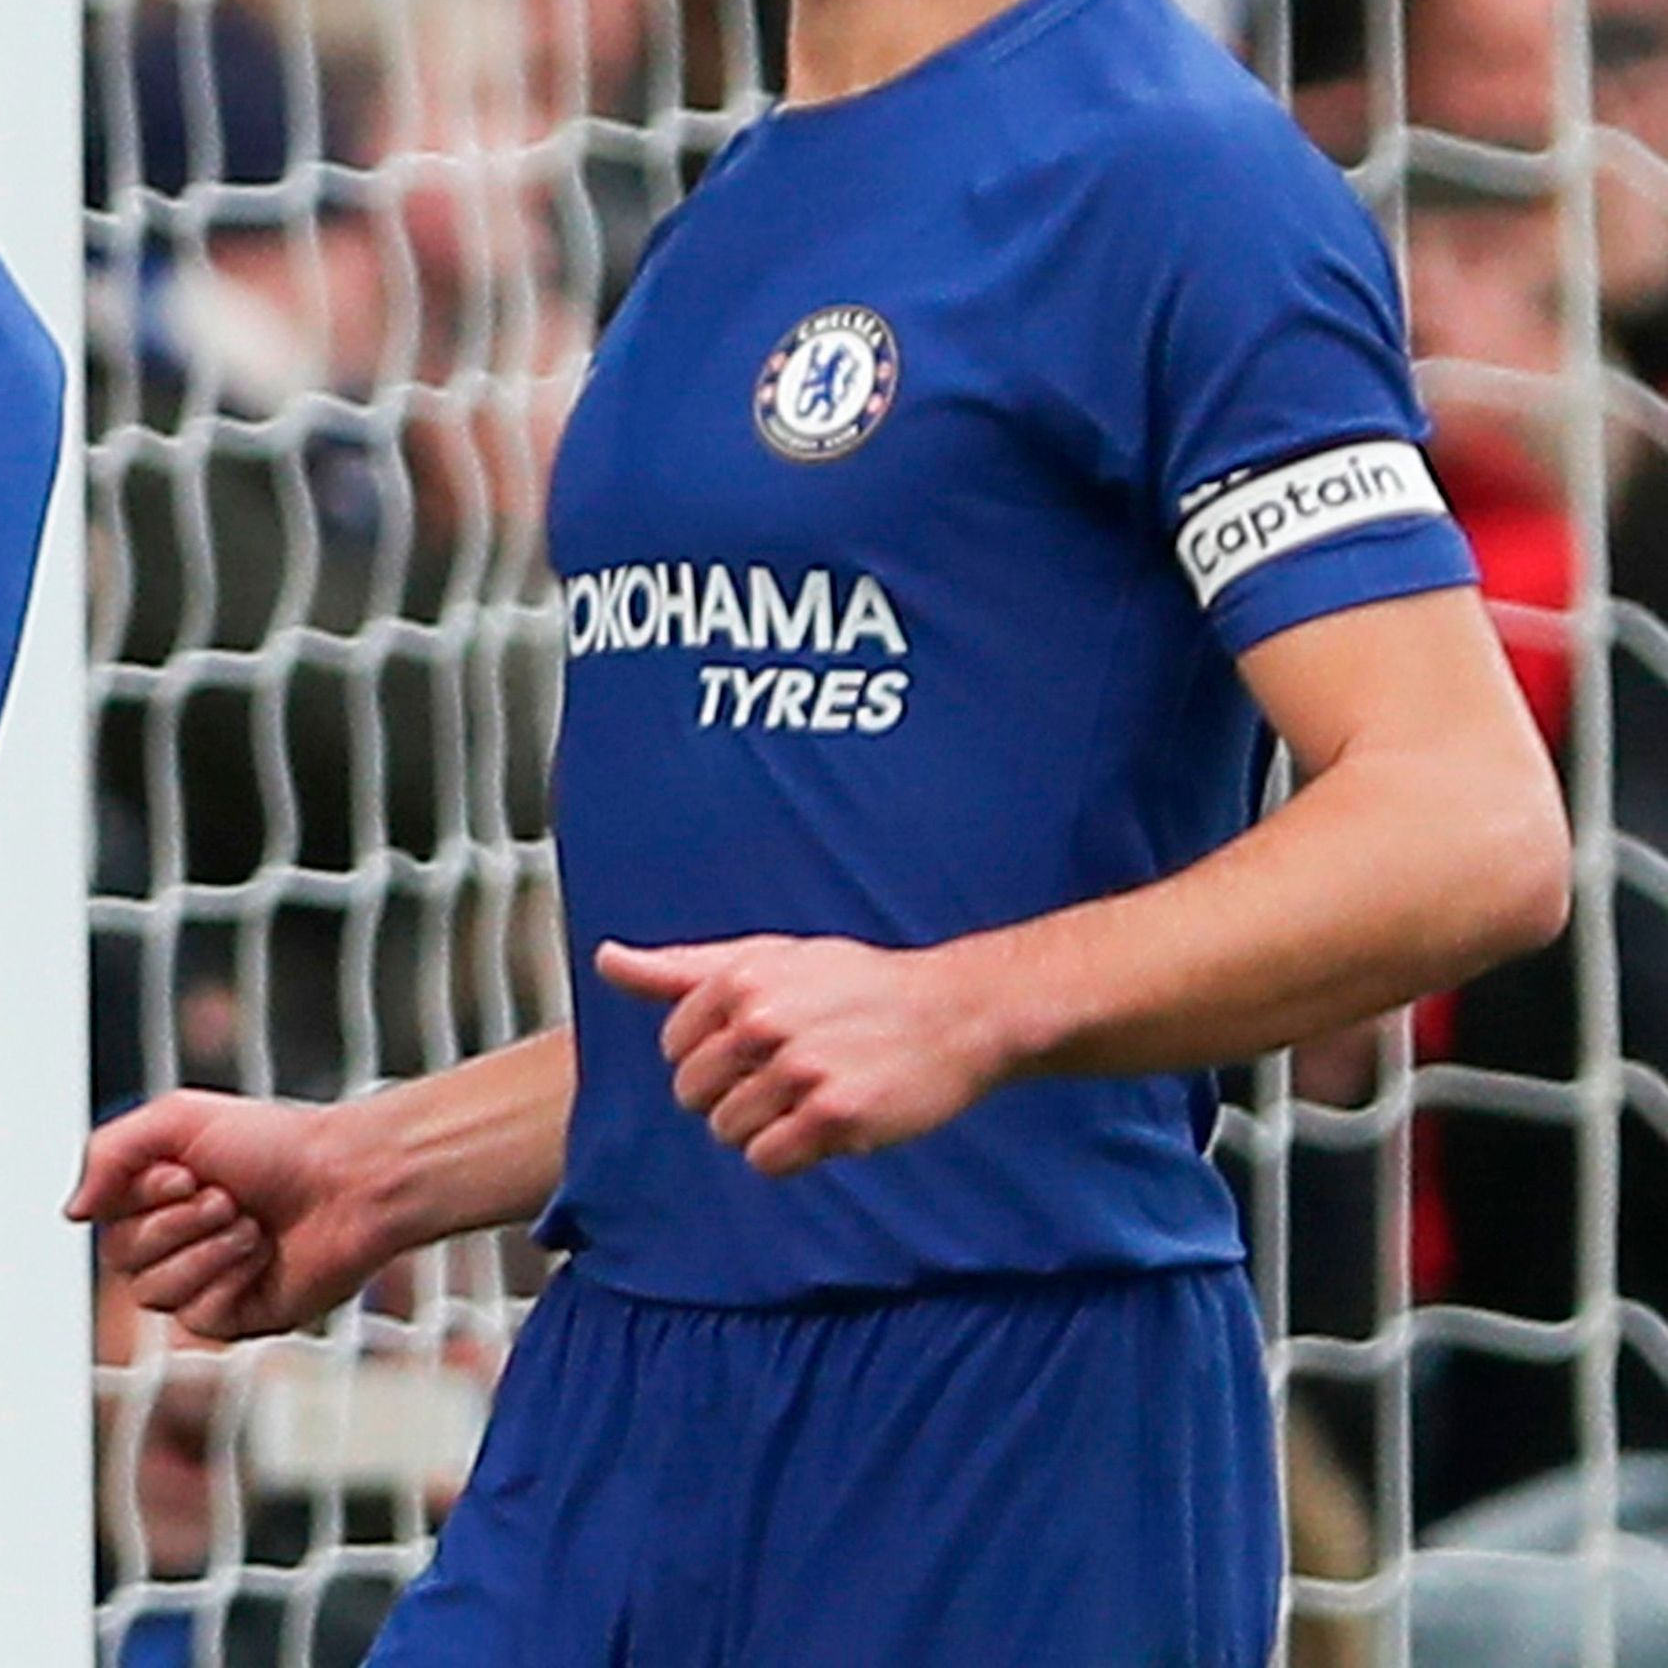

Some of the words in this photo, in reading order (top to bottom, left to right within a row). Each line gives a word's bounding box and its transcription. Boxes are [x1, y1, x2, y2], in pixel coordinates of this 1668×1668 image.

[1190, 456, 1405, 576] Captain
[566, 562, 908, 657] OKOHAMA
[698, 665, 910, 731] TYRES
